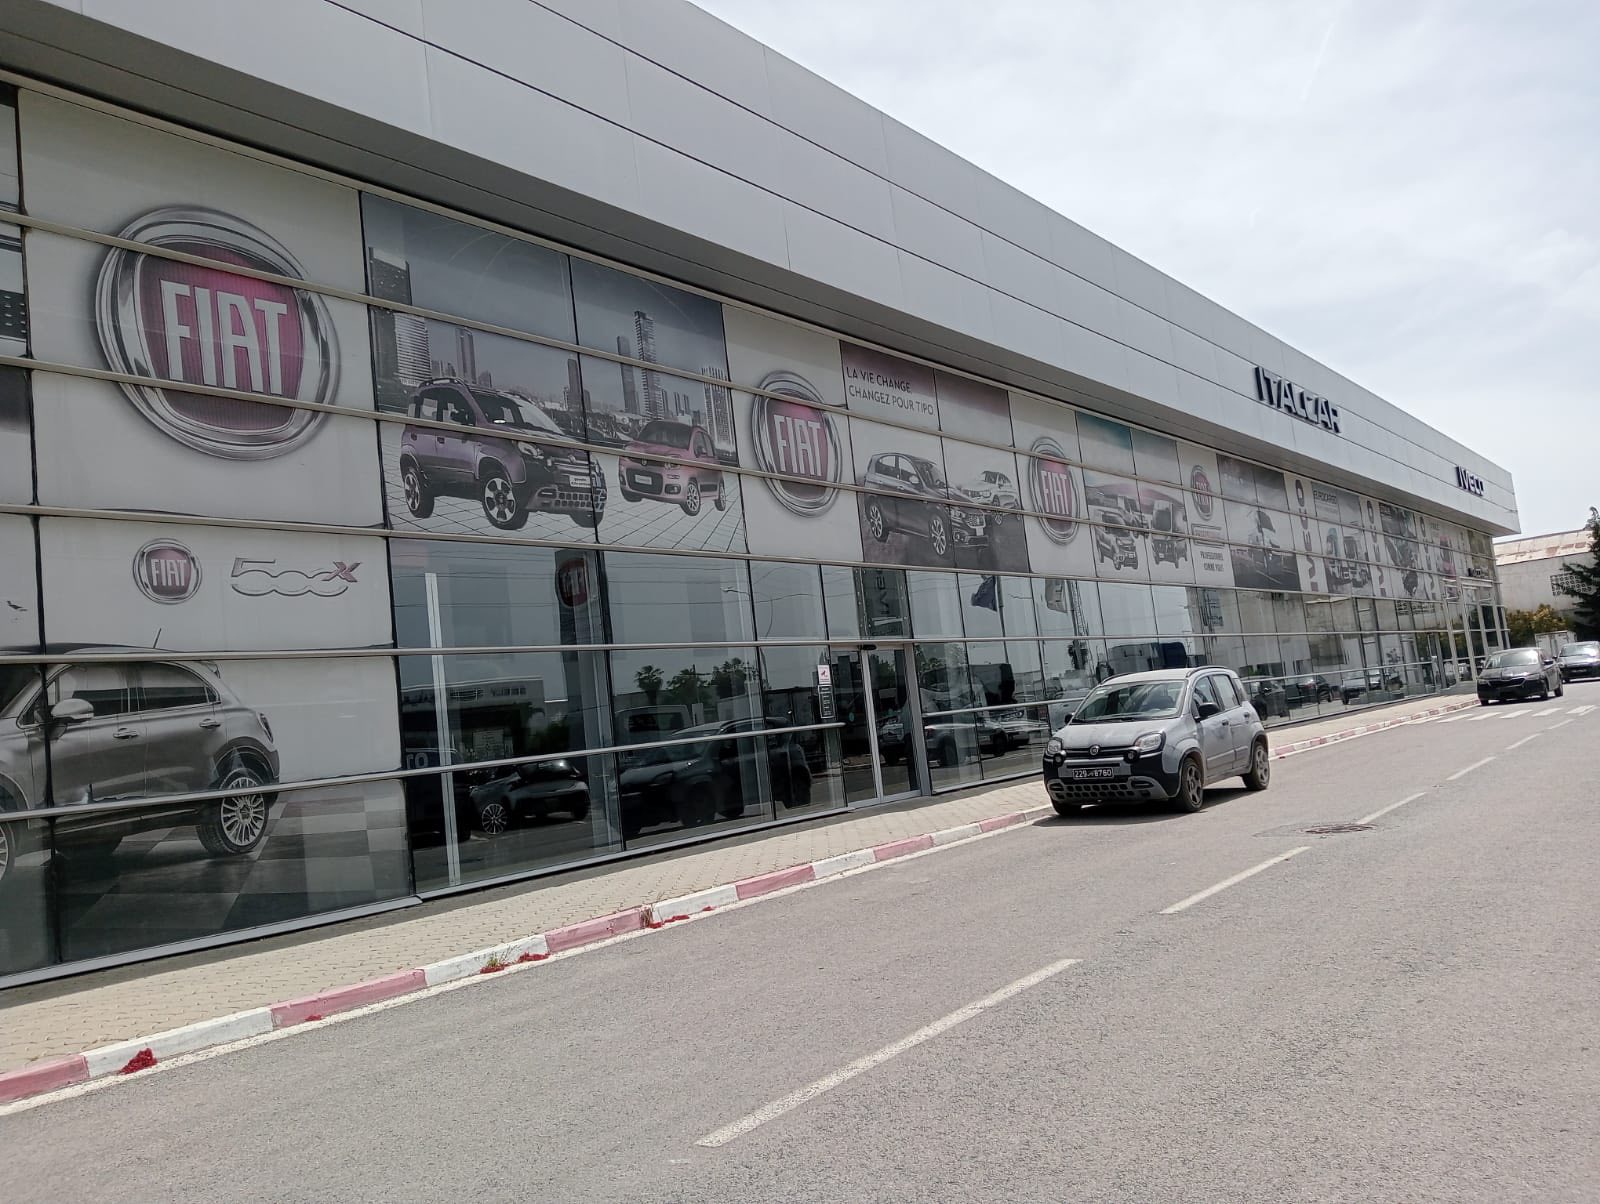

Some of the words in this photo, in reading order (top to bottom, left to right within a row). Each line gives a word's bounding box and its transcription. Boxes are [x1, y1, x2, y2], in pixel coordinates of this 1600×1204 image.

[160, 279, 288, 396] FIAT
[846, 366, 858, 379] LA
[860, 369, 875, 384] VIE
[848, 384, 891, 406] CHANGEZ
[892, 395, 915, 412] POUR
[1254, 366, 1341, 434] ITALCAR
[773, 414, 822, 477] FIAT
[1040, 470, 1072, 515] FIAT
[150, 558, 188, 588] FIAT
